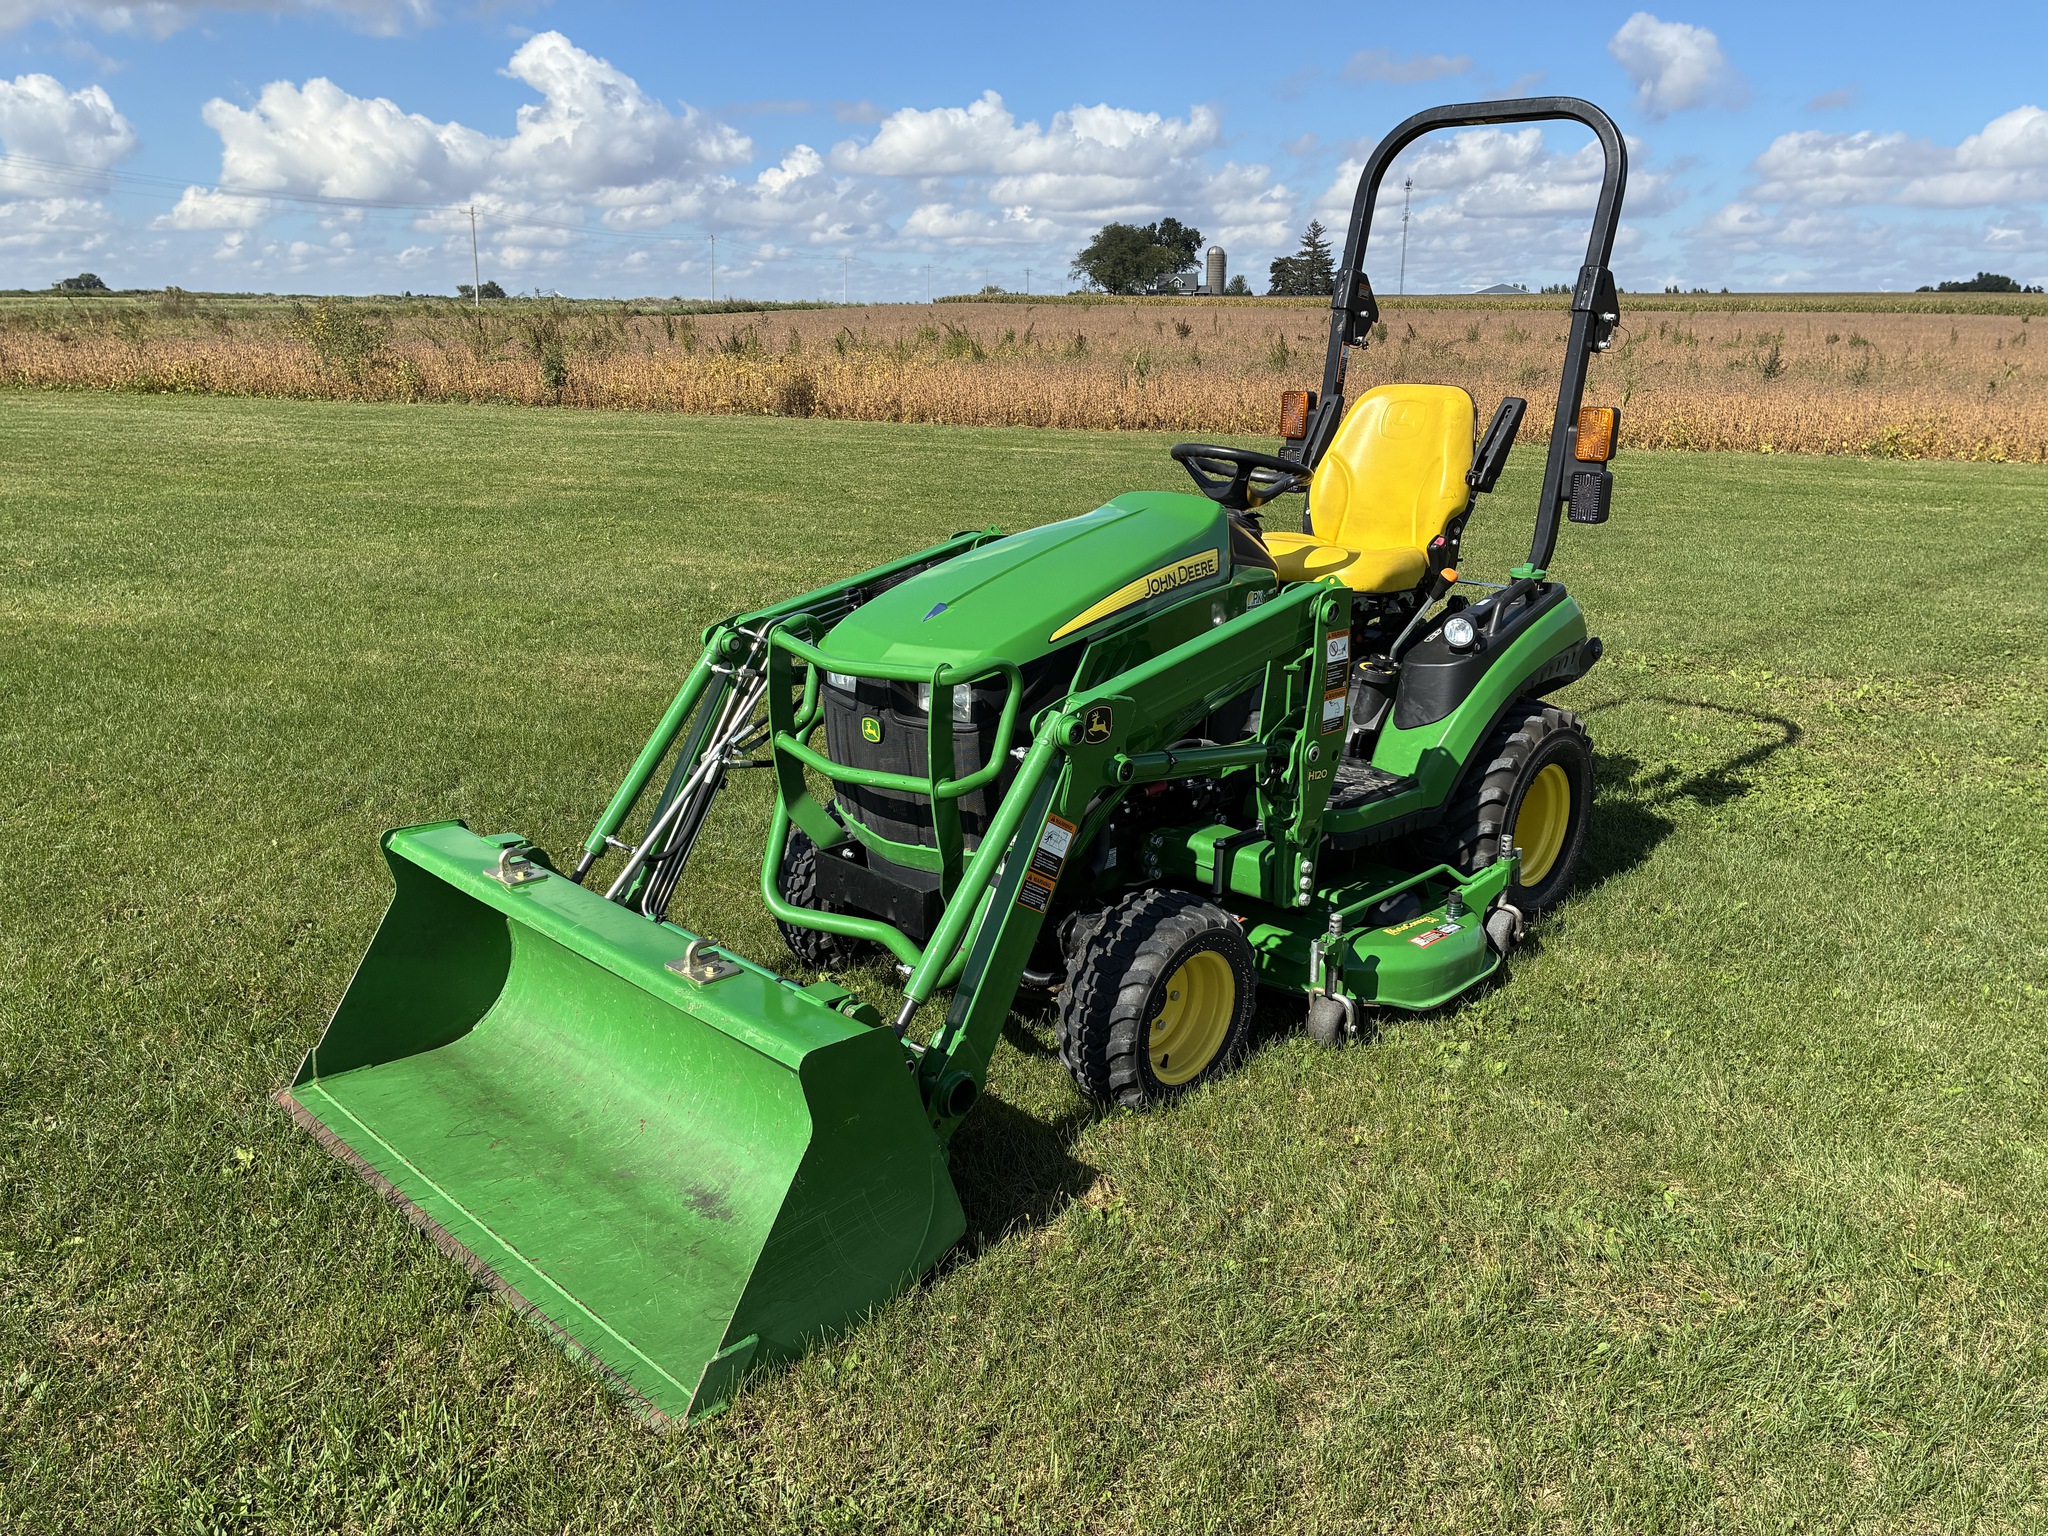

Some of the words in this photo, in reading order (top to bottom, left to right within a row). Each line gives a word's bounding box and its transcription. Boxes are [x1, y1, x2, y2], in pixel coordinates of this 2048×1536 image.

[1145, 571, 1177, 597] JOHN
[1177, 558, 1215, 583] DEERE
[1307, 768, 1328, 781] H120
[1055, 817, 1074, 831] WARNING
[1034, 876, 1052, 889] WARNING
